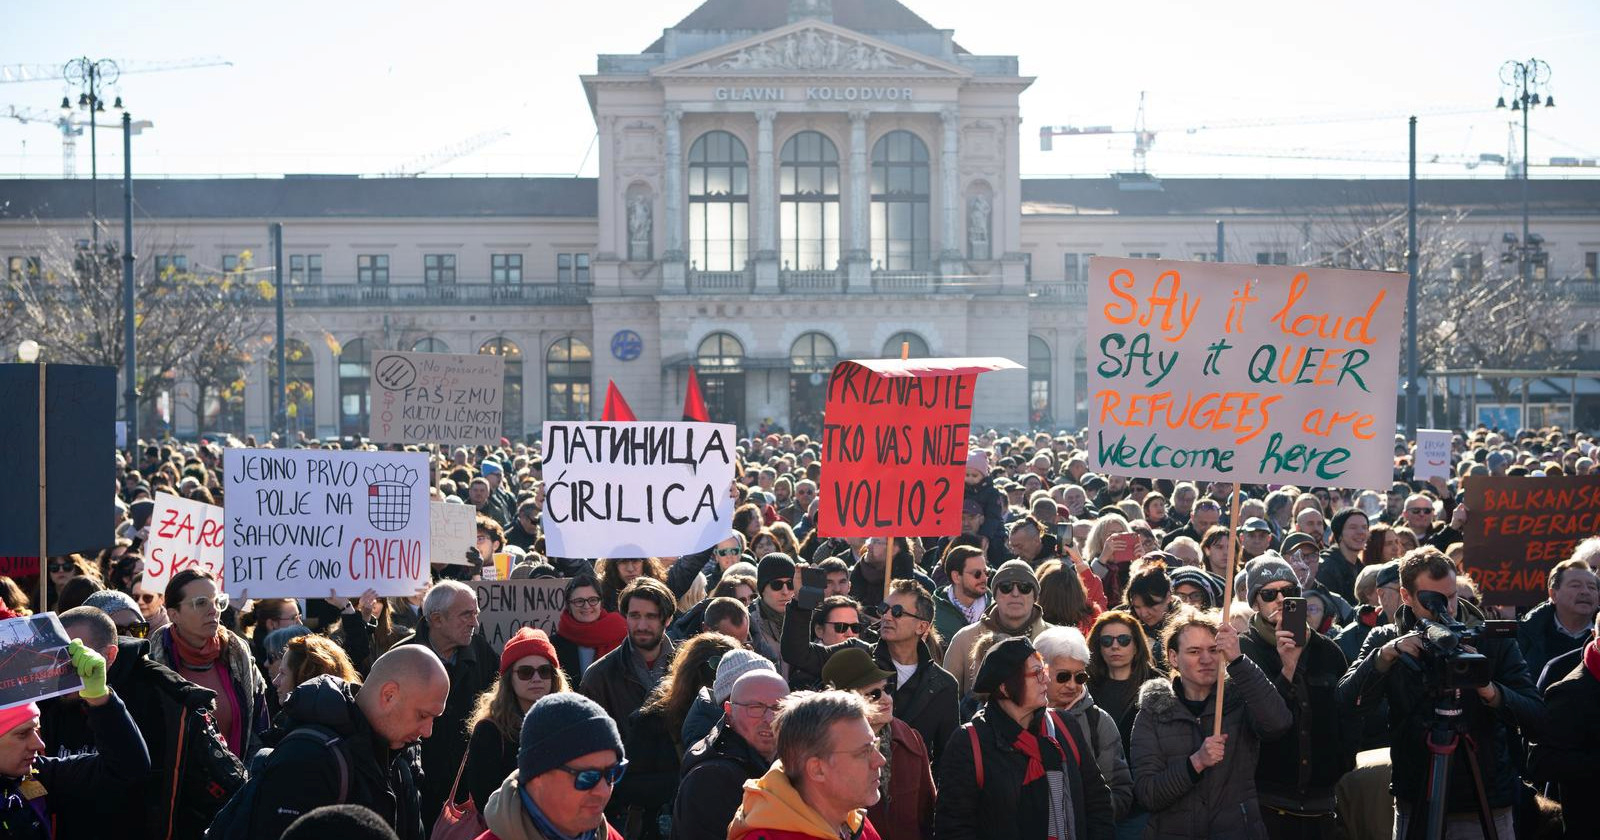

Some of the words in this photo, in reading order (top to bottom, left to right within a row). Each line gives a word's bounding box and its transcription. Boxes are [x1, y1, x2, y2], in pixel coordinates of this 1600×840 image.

[716, 87, 785, 100] GLAVNI
[806, 87, 913, 100] KOLODVOR
[1225, 280, 1258, 333] it
[1271, 272, 1387, 344] loud
[420, 376, 460, 387] STOP
[828, 361, 971, 410] PRIZNAJTE
[1203, 338, 1232, 376] it
[1248, 344, 1371, 393] QUEER
[381, 391, 396, 437] STOP
[403, 405, 440, 420] KULTU
[445, 407, 502, 424] LIČNOSTI
[405, 385, 496, 405] FAŠIZMU
[1095, 390, 1283, 444] REFUGEES
[1301, 408, 1378, 440] are
[403, 424, 497, 440] KOMUNIZMU
[543, 425, 730, 473] ЛАТИНИЦА
[825, 424, 865, 463] TKO
[875, 425, 912, 465] VAS
[922, 424, 970, 466] NIJE
[233, 456, 297, 484] JEDINO
[307, 461, 359, 486] PRVO
[1098, 430, 1233, 471] Welcome
[1259, 432, 1351, 479] here
[256, 490, 316, 516] POLJE
[325, 493, 354, 515] NA
[545, 470, 719, 525] ĆIRILICA
[834, 477, 950, 528] VOLIO?
[233, 517, 344, 548] ŠAHOVNICI
[1526, 540, 1577, 562] BEZ
[232, 555, 268, 583] BIT
[276, 553, 299, 581] ĆE
[308, 559, 341, 579] ONO
[348, 536, 422, 581] CRVENO
